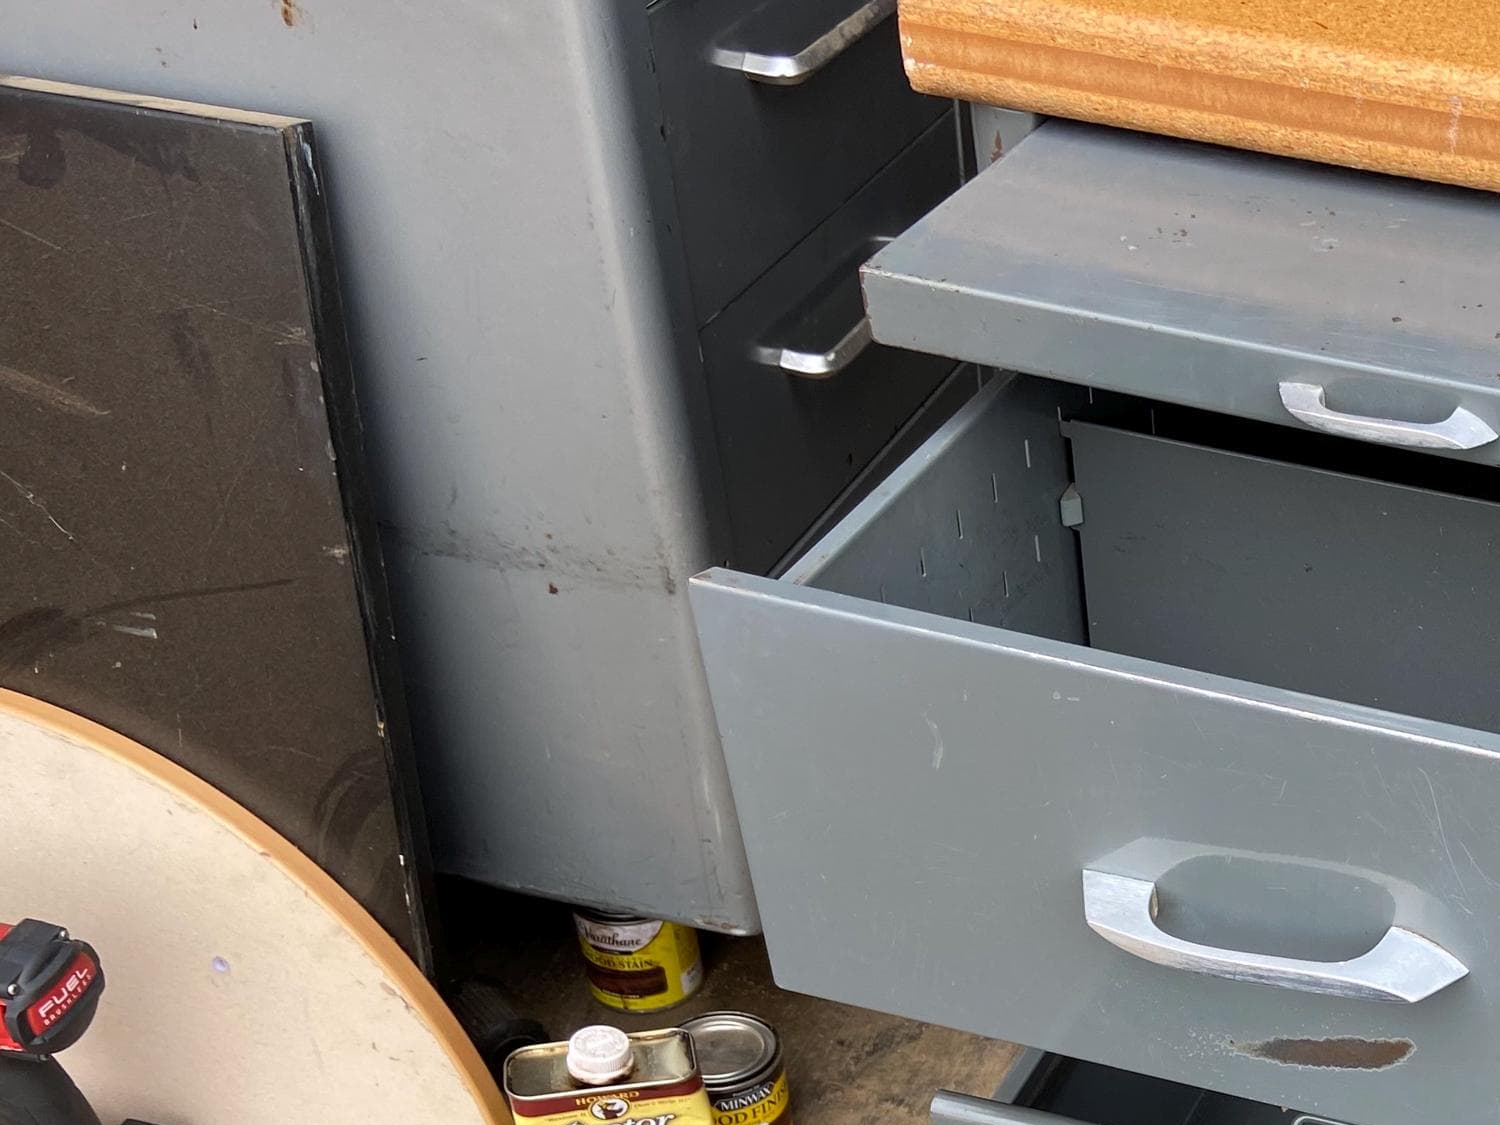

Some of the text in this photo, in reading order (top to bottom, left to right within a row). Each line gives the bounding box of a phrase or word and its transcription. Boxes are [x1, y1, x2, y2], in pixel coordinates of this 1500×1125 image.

[38, 968, 88, 1018] FUEL
[43, 974, 92, 1025] BRUSHLESS
[575, 1090, 640, 1106] HOWARD
[721, 1082, 774, 1111] MINWAX
[714, 1112, 748, 1125] OD
